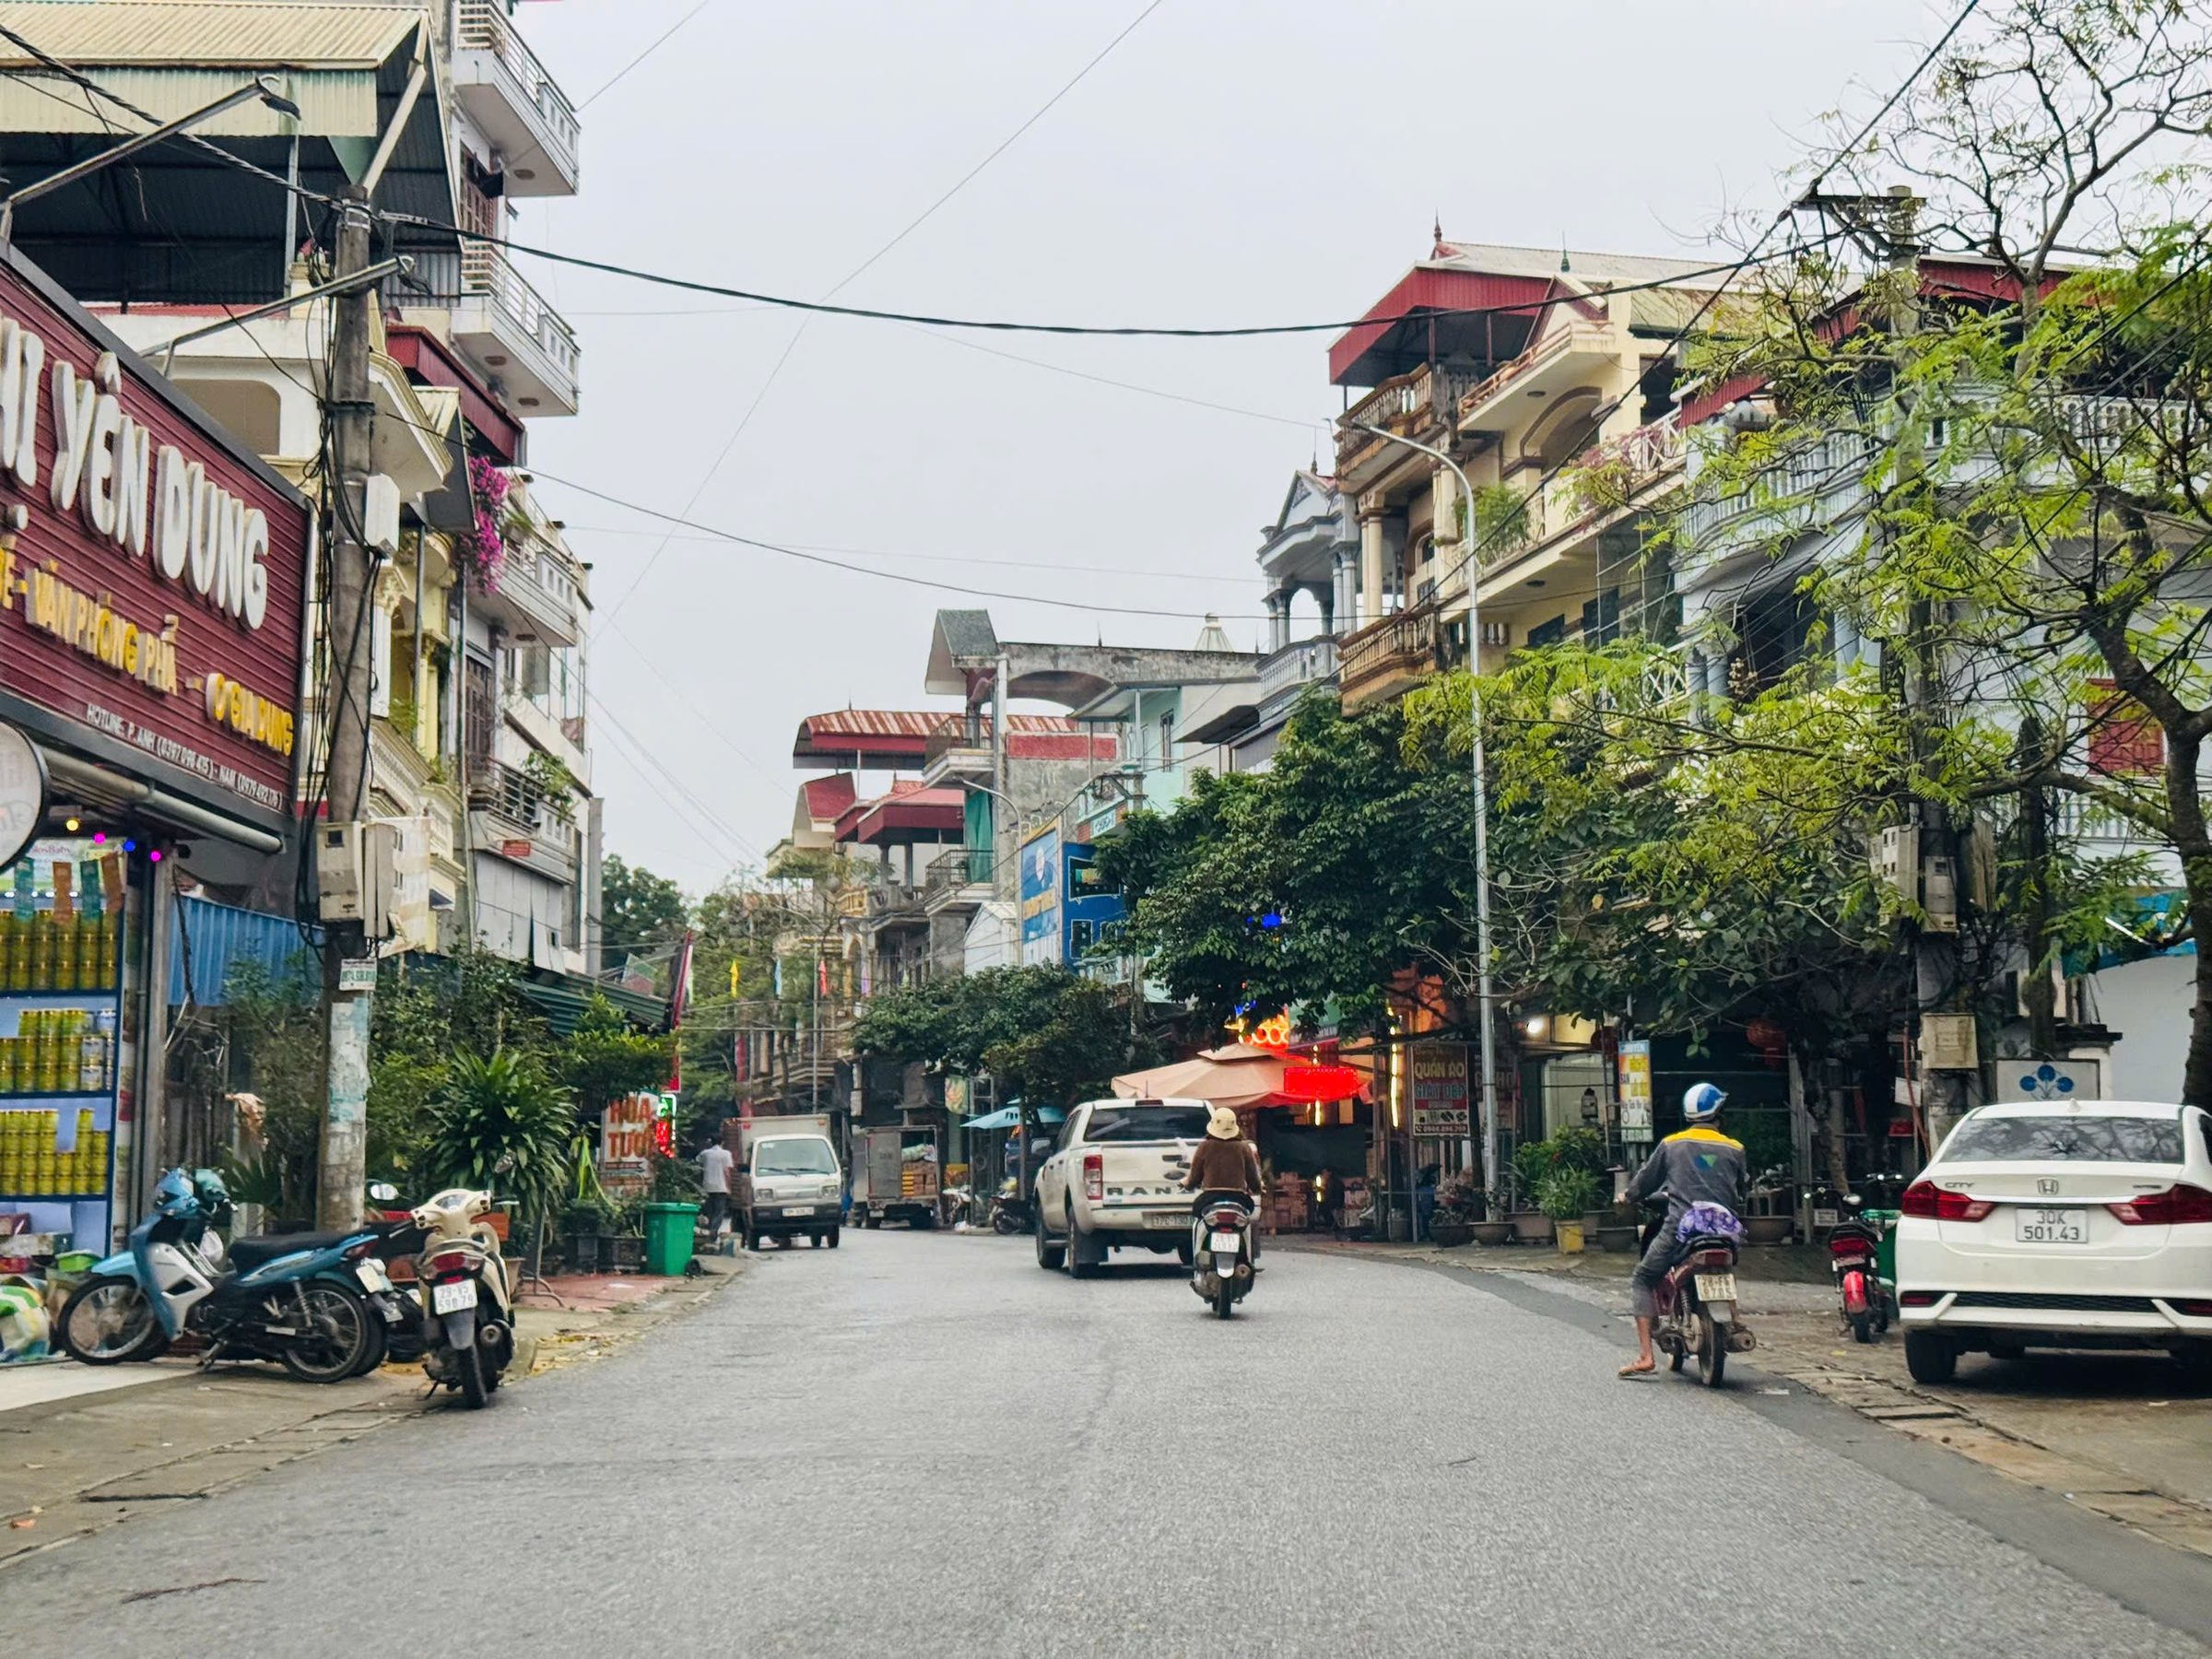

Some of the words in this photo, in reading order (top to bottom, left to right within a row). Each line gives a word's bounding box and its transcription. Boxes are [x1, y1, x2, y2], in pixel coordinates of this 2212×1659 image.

[153, 445, 268, 630] DUNG
[2036, 1210, 2066, 1225] 30K
[2023, 1226, 2079, 1241] 501.43
